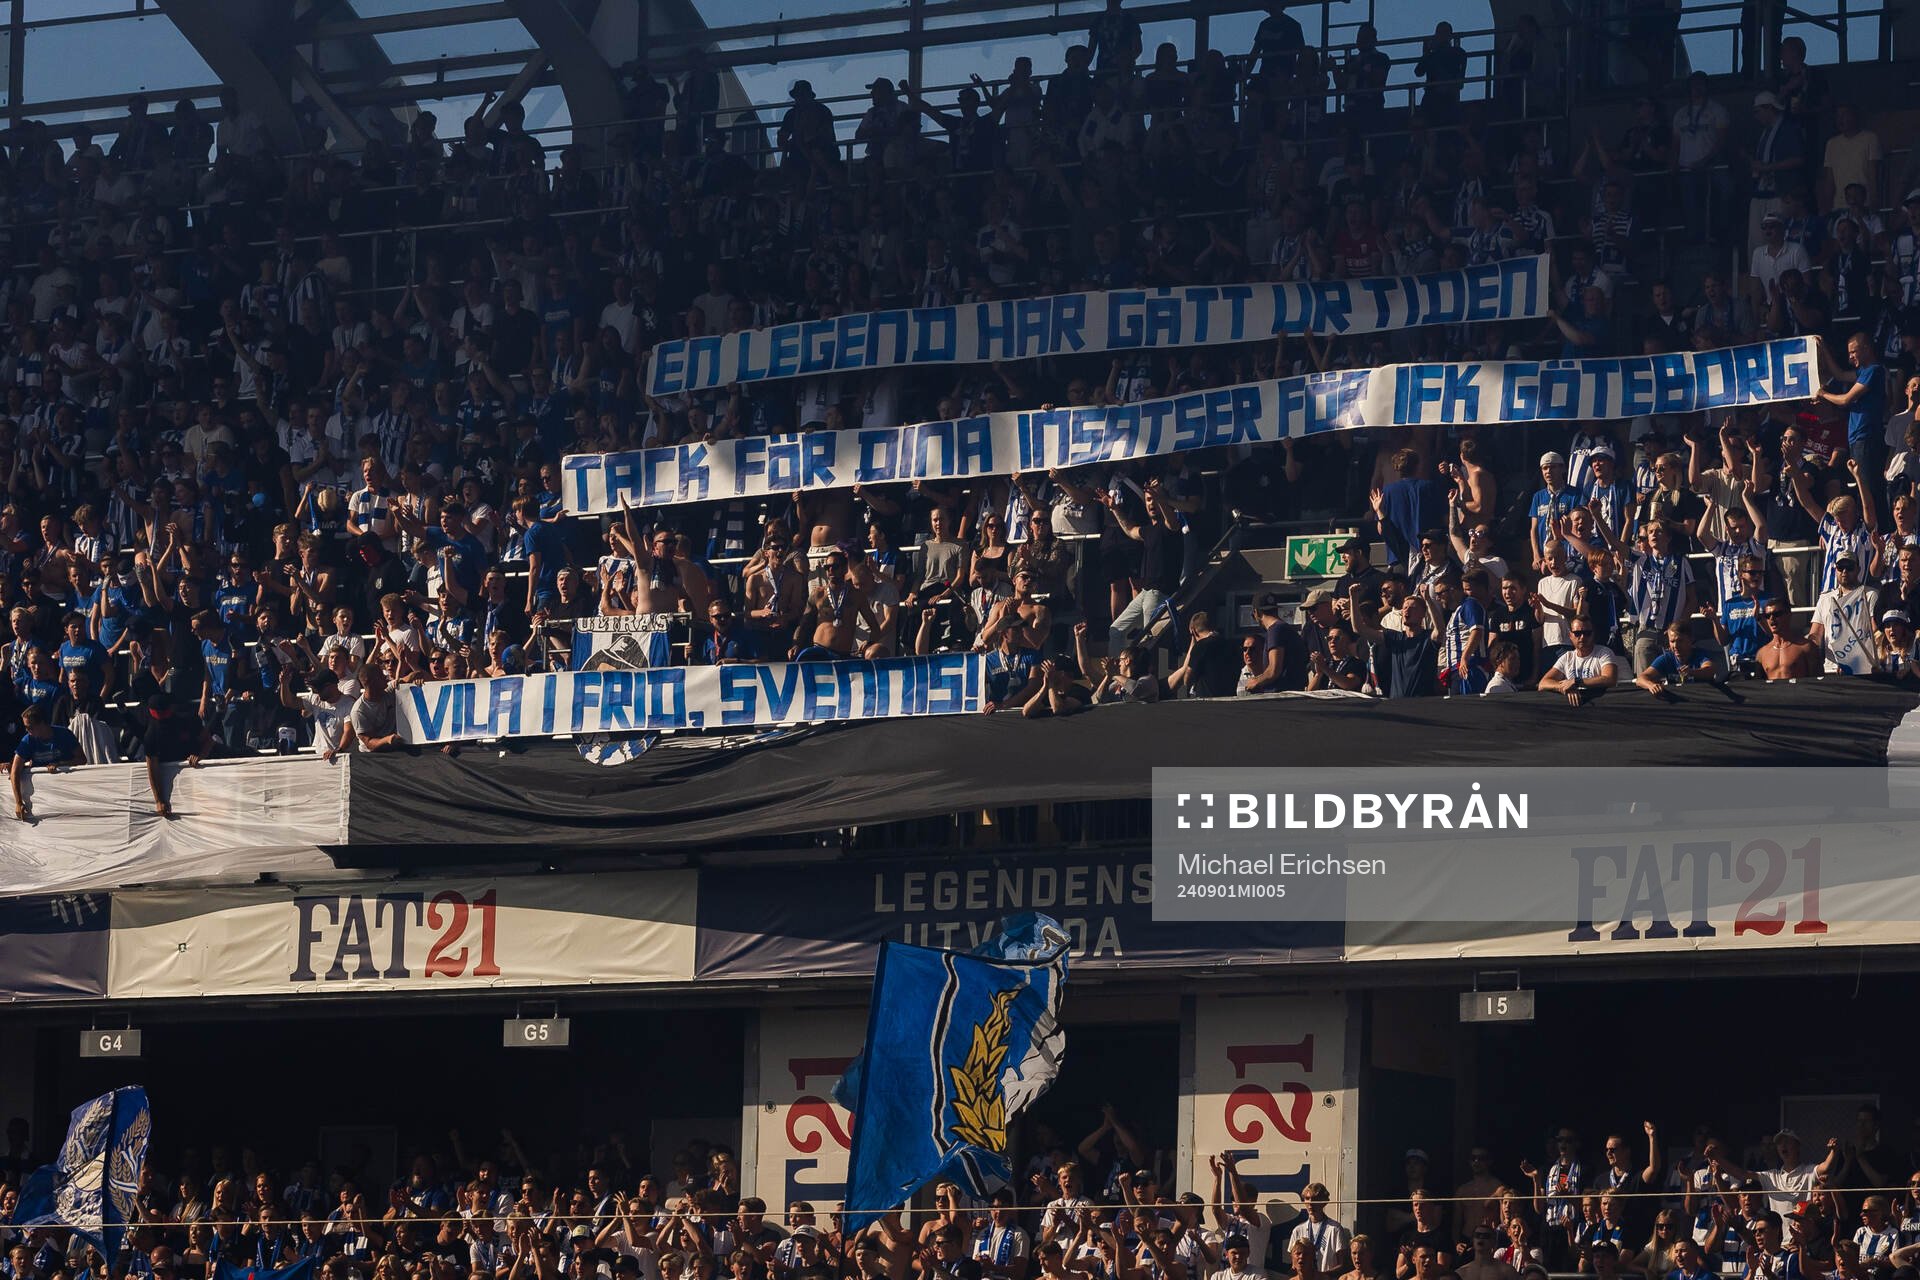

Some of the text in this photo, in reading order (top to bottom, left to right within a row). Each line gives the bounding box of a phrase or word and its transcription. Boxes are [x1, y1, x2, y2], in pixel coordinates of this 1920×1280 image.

[652, 335, 722, 394] EN
[736, 306, 956, 382] LEGEND
[976, 294, 1087, 359] HAR
[1272, 281, 1351, 335] UR
[1360, 257, 1539, 327] TIDEN
[564, 338, 1810, 512] TACK FÖR DINA INSATSER FÖR IFK GÖTEBORG
[576, 613, 670, 633] ULTRAS
[410, 653, 980, 741] VILA I FRID, SVENNIS!
[874, 863, 1157, 913] LEGENDENS
[1568, 837, 1828, 943] FAT21
[289, 889, 501, 982] FAT21
[904, 916, 1122, 957] UTVDA
[99, 1035, 123, 1052] G4
[524, 1023, 549, 1041] G5
